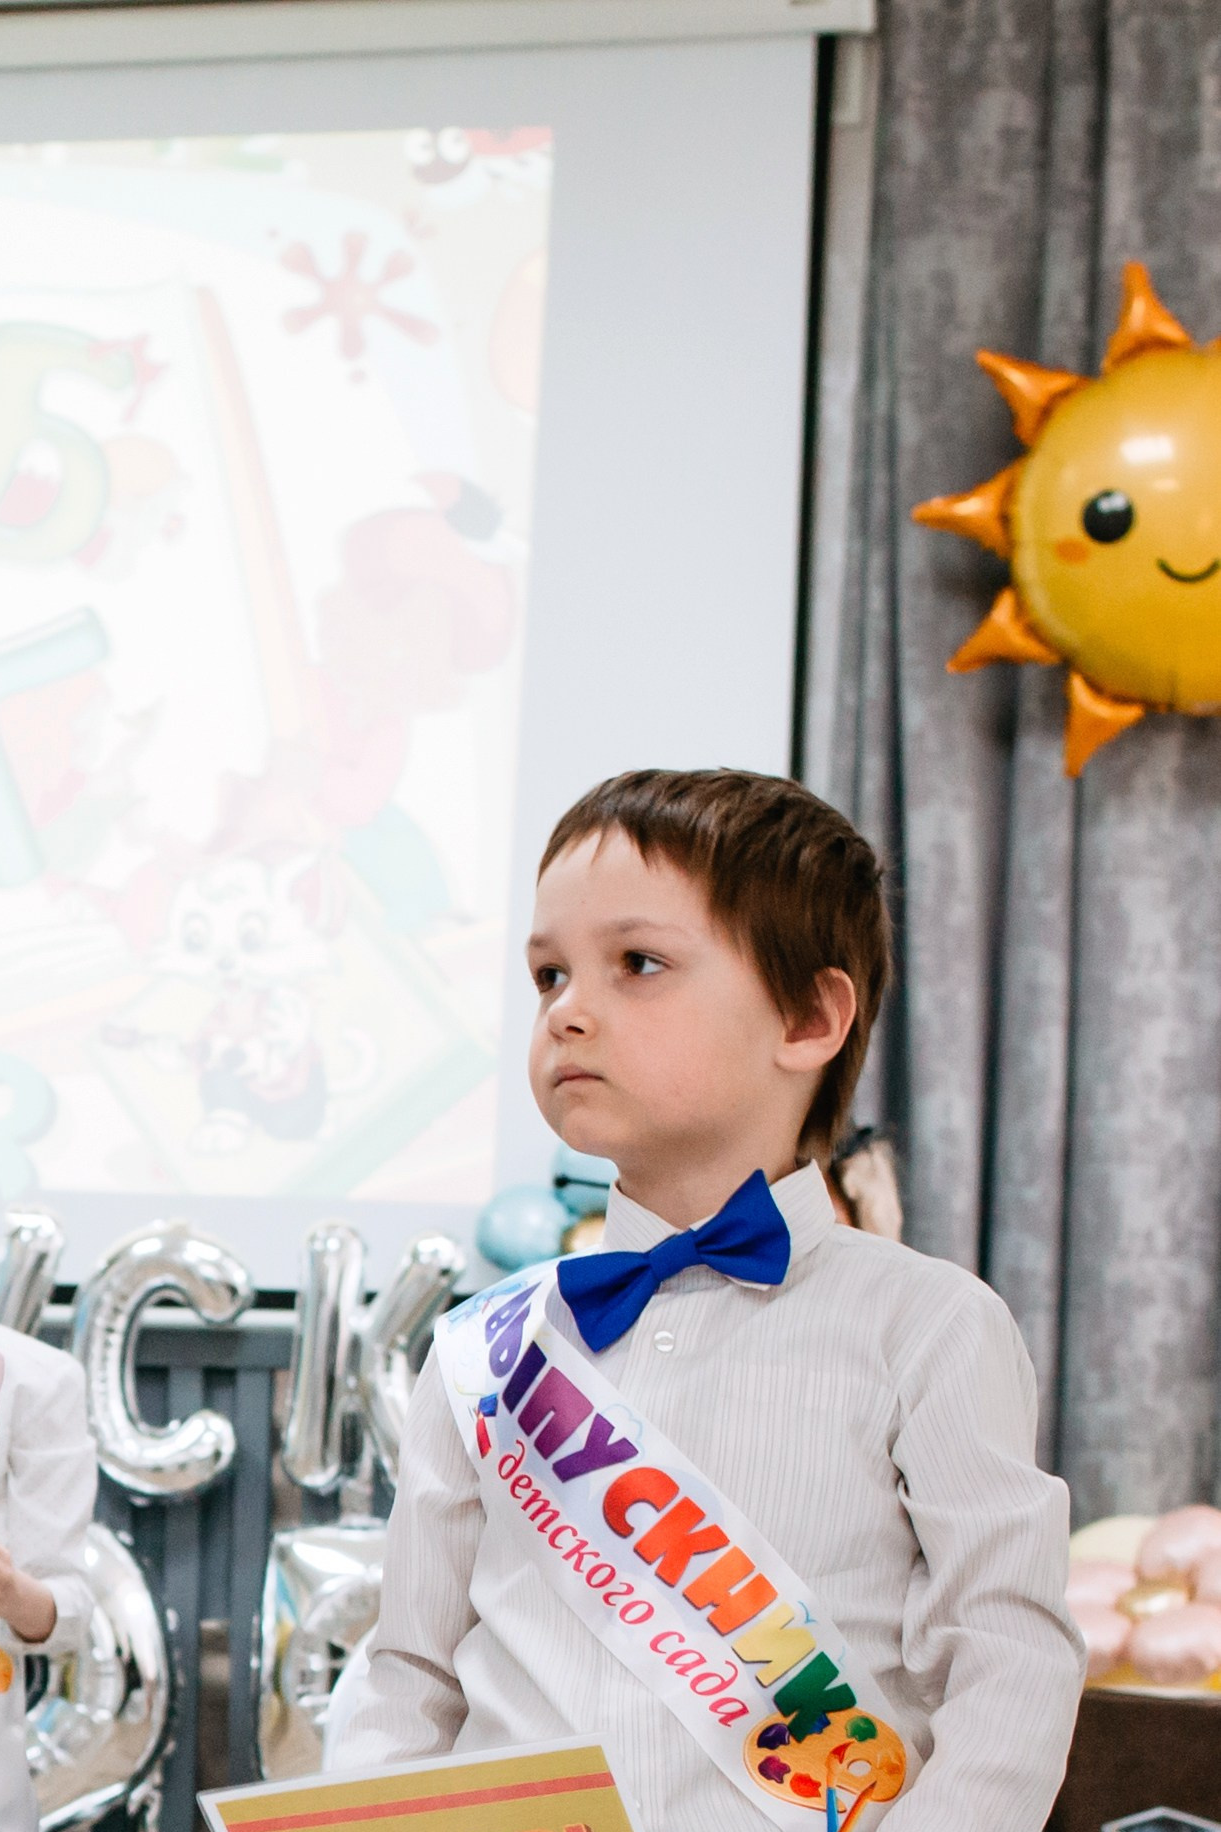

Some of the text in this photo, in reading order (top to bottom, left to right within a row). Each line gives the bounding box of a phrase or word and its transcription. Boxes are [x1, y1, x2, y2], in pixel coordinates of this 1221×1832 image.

[484, 1280, 858, 1743] ВЫПУСКНИК
[497, 1439, 750, 1729] детского сада
